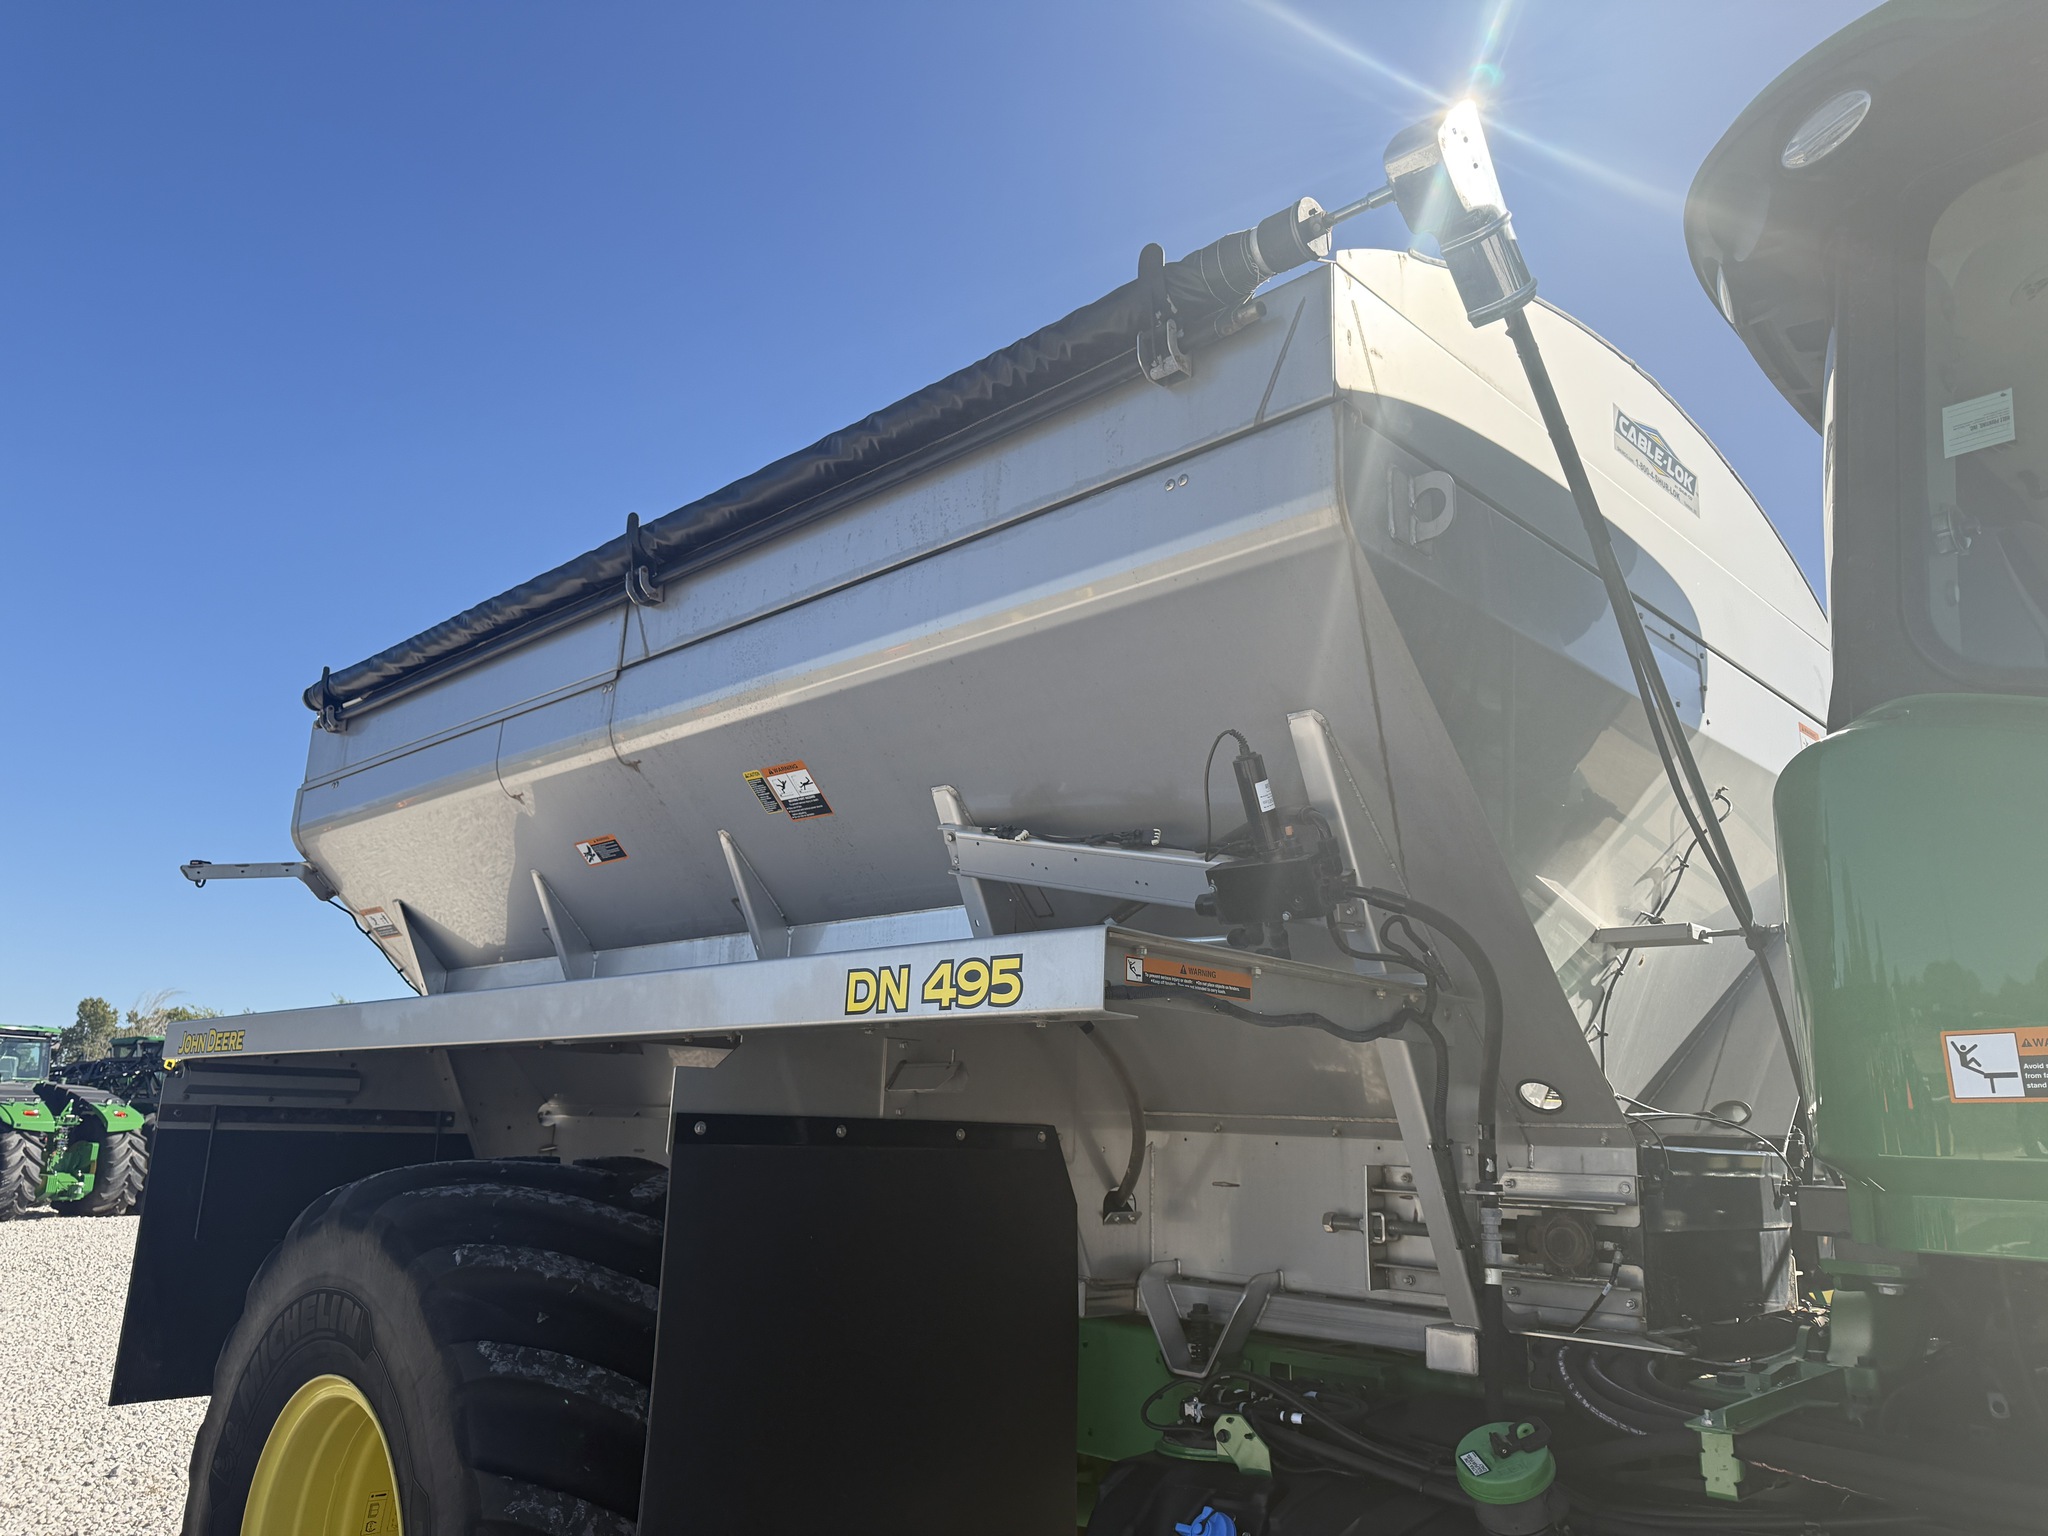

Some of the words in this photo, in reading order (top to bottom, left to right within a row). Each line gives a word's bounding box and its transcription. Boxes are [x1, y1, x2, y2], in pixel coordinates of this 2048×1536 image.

[845, 964, 911, 1015] DN
[921, 953, 1024, 1010] 495
[1188, 967, 1217, 979] WARNING
[178, 1030, 207, 1054] JOHN
[206, 1028, 245, 1053] DEERE
[238, 1292, 362, 1418] MICHELIN
